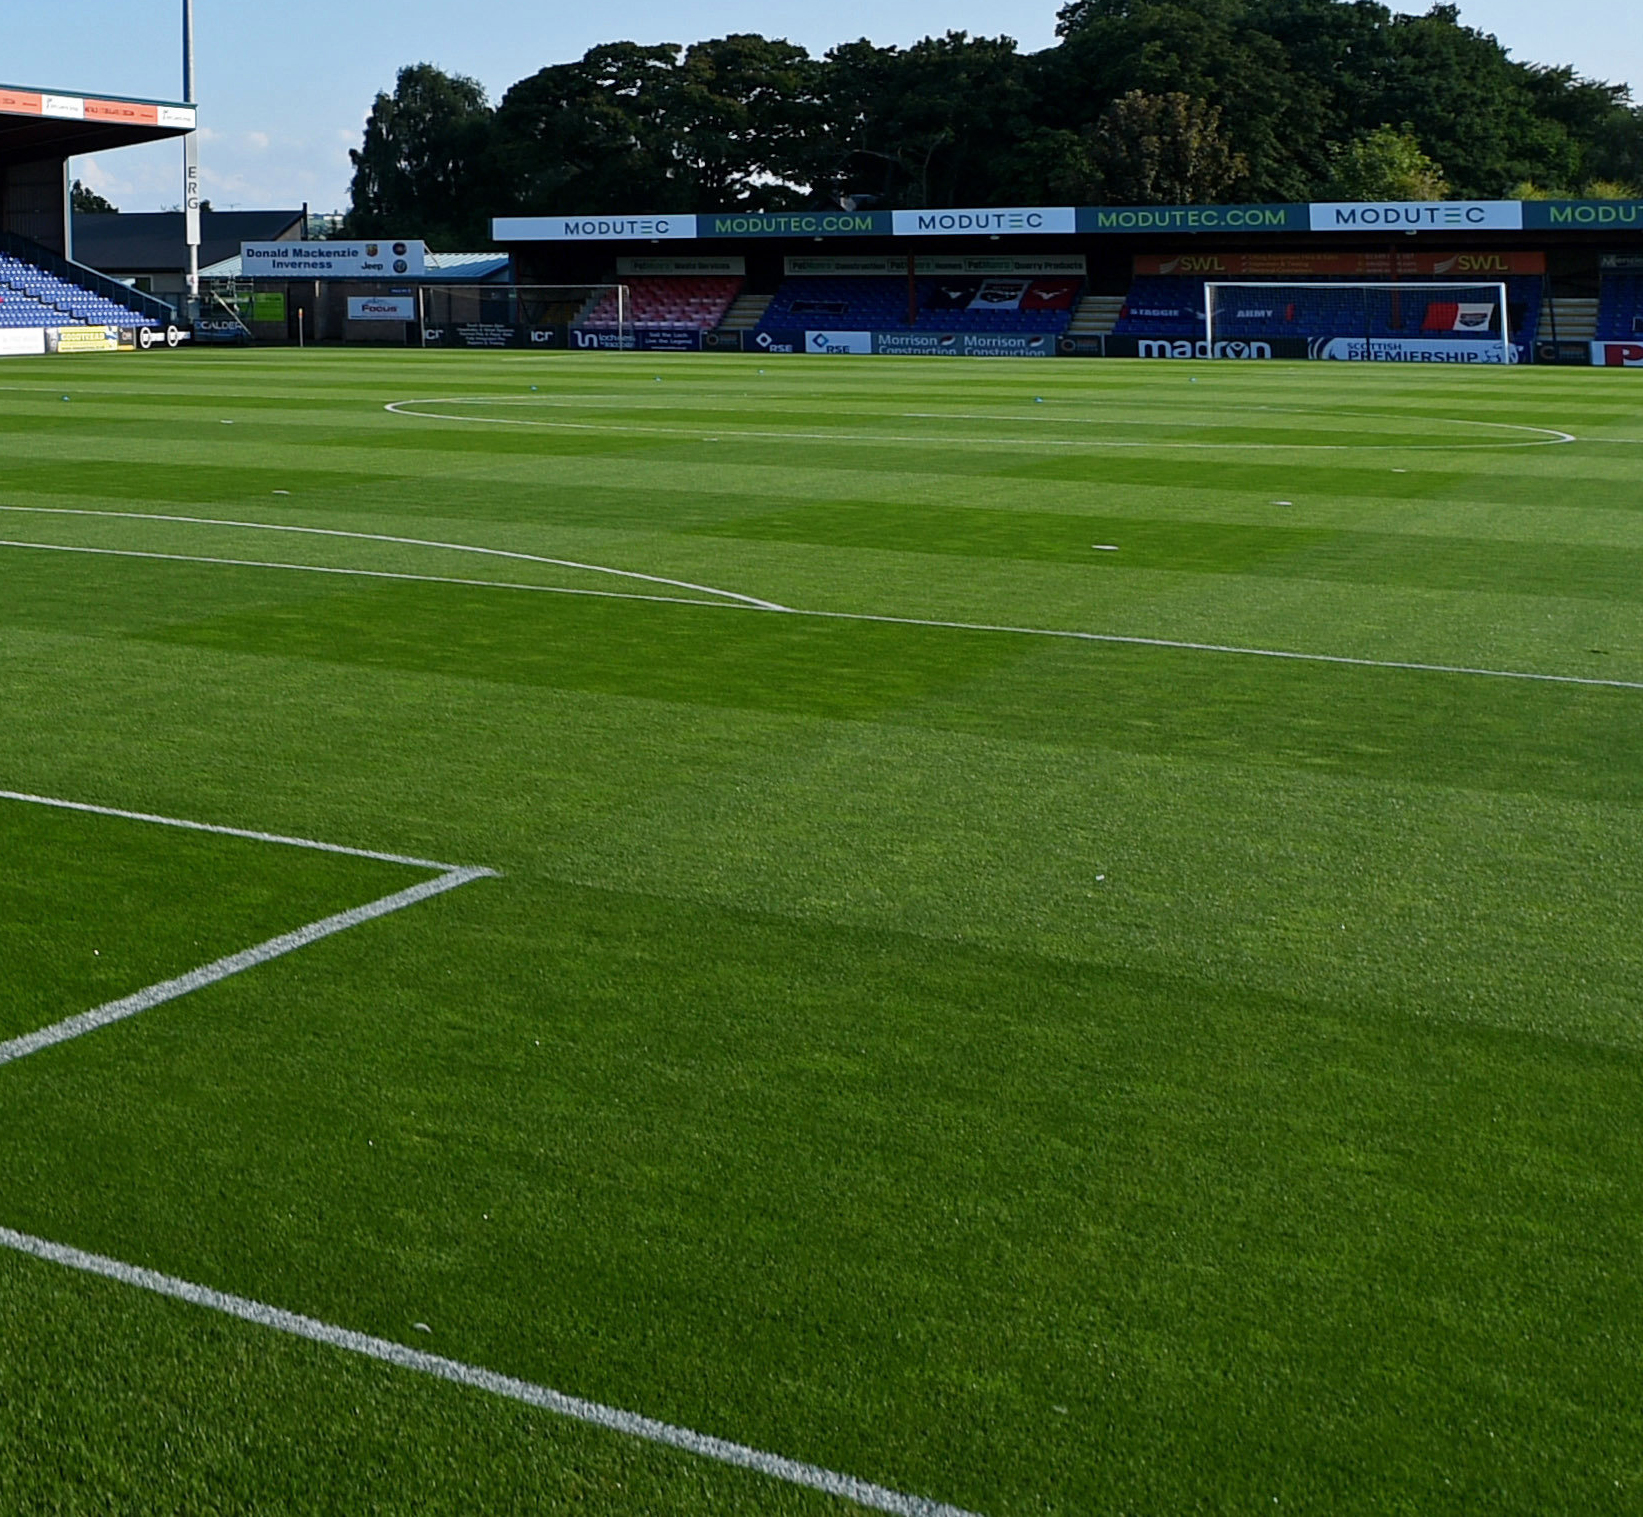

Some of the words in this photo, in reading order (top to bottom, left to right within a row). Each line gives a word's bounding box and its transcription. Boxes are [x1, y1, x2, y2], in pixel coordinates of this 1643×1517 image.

[188, 166, 199, 209] ERG
[918, 213, 1043, 229] MODUTEC
[1098, 210, 1285, 227] MODUTEC.COM
[1335, 206, 1485, 224] MODUTEC
[565, 220, 669, 235] MODUTEC
[715, 216, 873, 233] MODUTEC.COM
[246, 248, 289, 258] Donald
[294, 248, 359, 258] Mackenzie
[271, 260, 333, 269] Inverness
[361, 262, 384, 271] Jeep
[1014, 262, 1042, 271] Quarry
[1044, 262, 1083, 270] Products
[1181, 256, 1226, 271] SWL
[1458, 255, 1509, 271] SWL
[361, 304, 398, 313] Focus
[879, 333, 938, 346] Morrison
[965, 335, 1026, 348] Morrison
[1347, 341, 1402, 350] SCOTTISH
[769, 344, 793, 353] RSE
[826, 344, 850, 353] RSE
[1347, 349, 1478, 363] PREMIERSHIP
